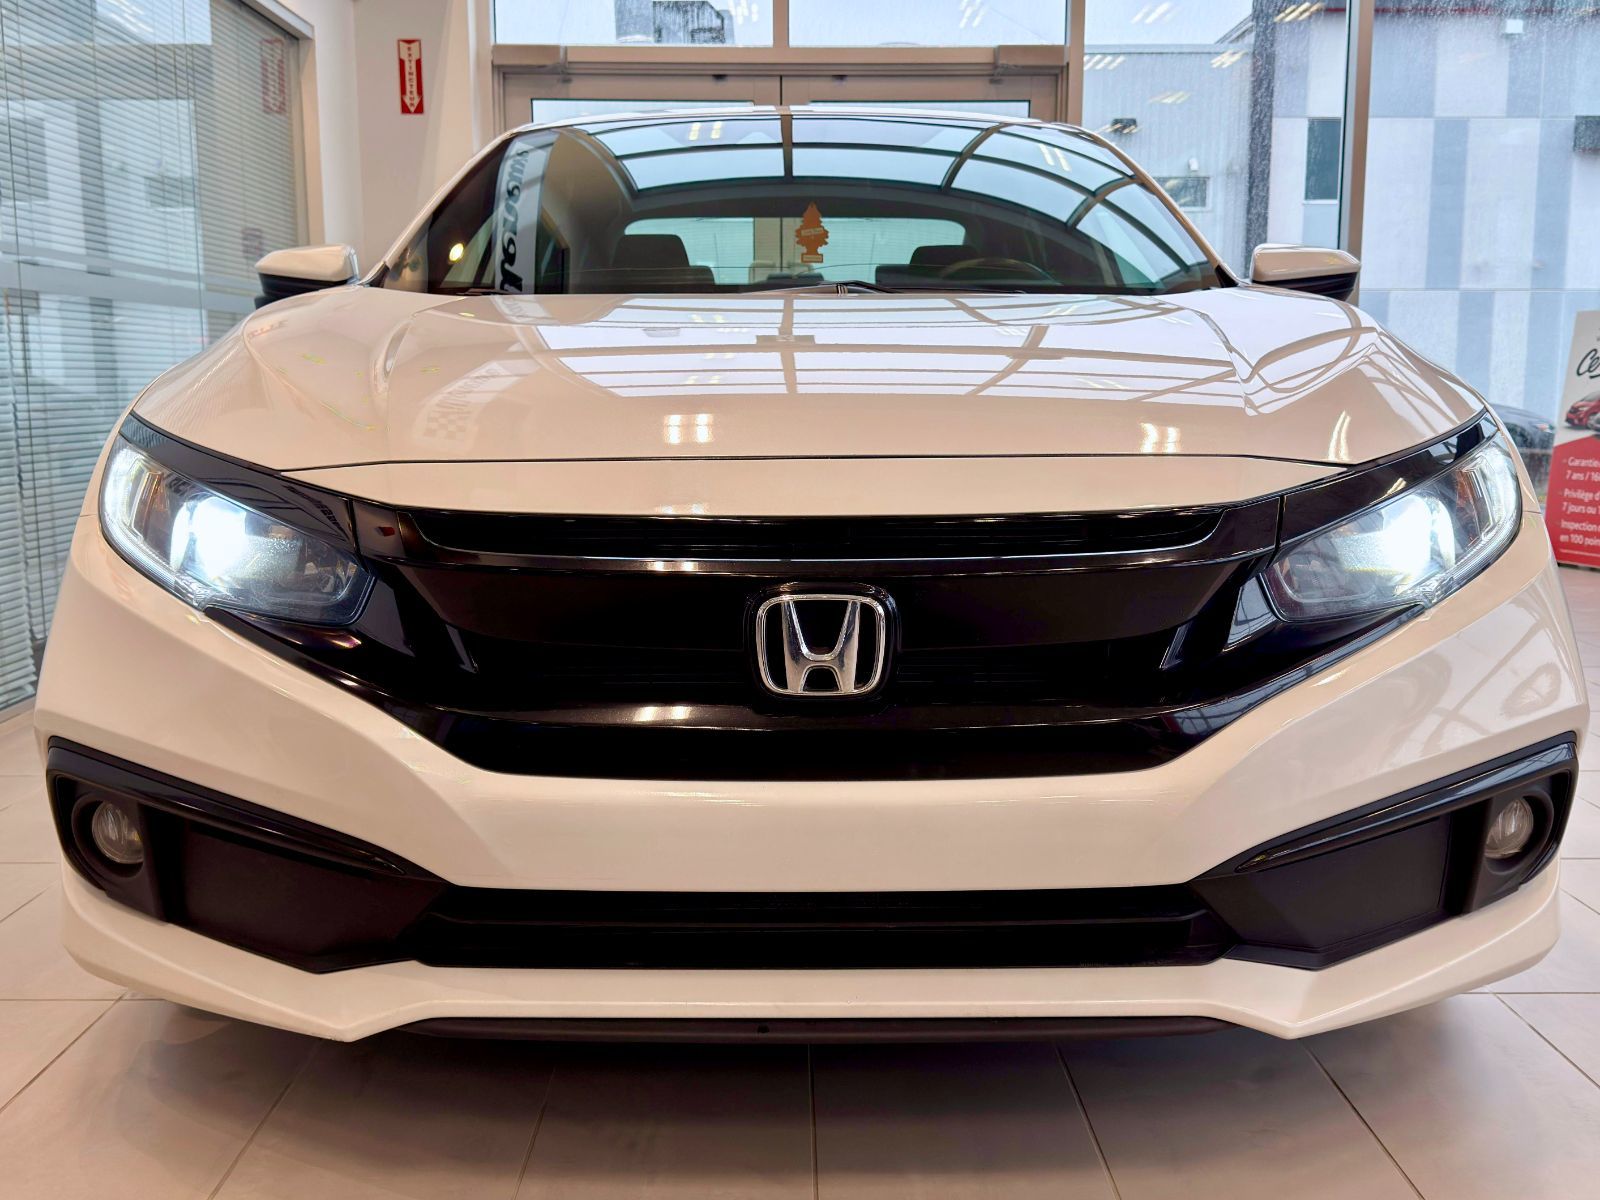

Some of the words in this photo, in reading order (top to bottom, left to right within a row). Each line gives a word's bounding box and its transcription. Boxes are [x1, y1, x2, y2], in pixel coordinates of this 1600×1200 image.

[407, 46, 415, 107] EXTINCTEUR
[1568, 457, 1600, 467] Garantie
[1566, 470, 1571, 480] 7
[1567, 502, 1586, 514] jours
[1586, 506, 1597, 514] ou
[1561, 519, 1597, 531] Inspection
[1570, 534, 1584, 544] 100
